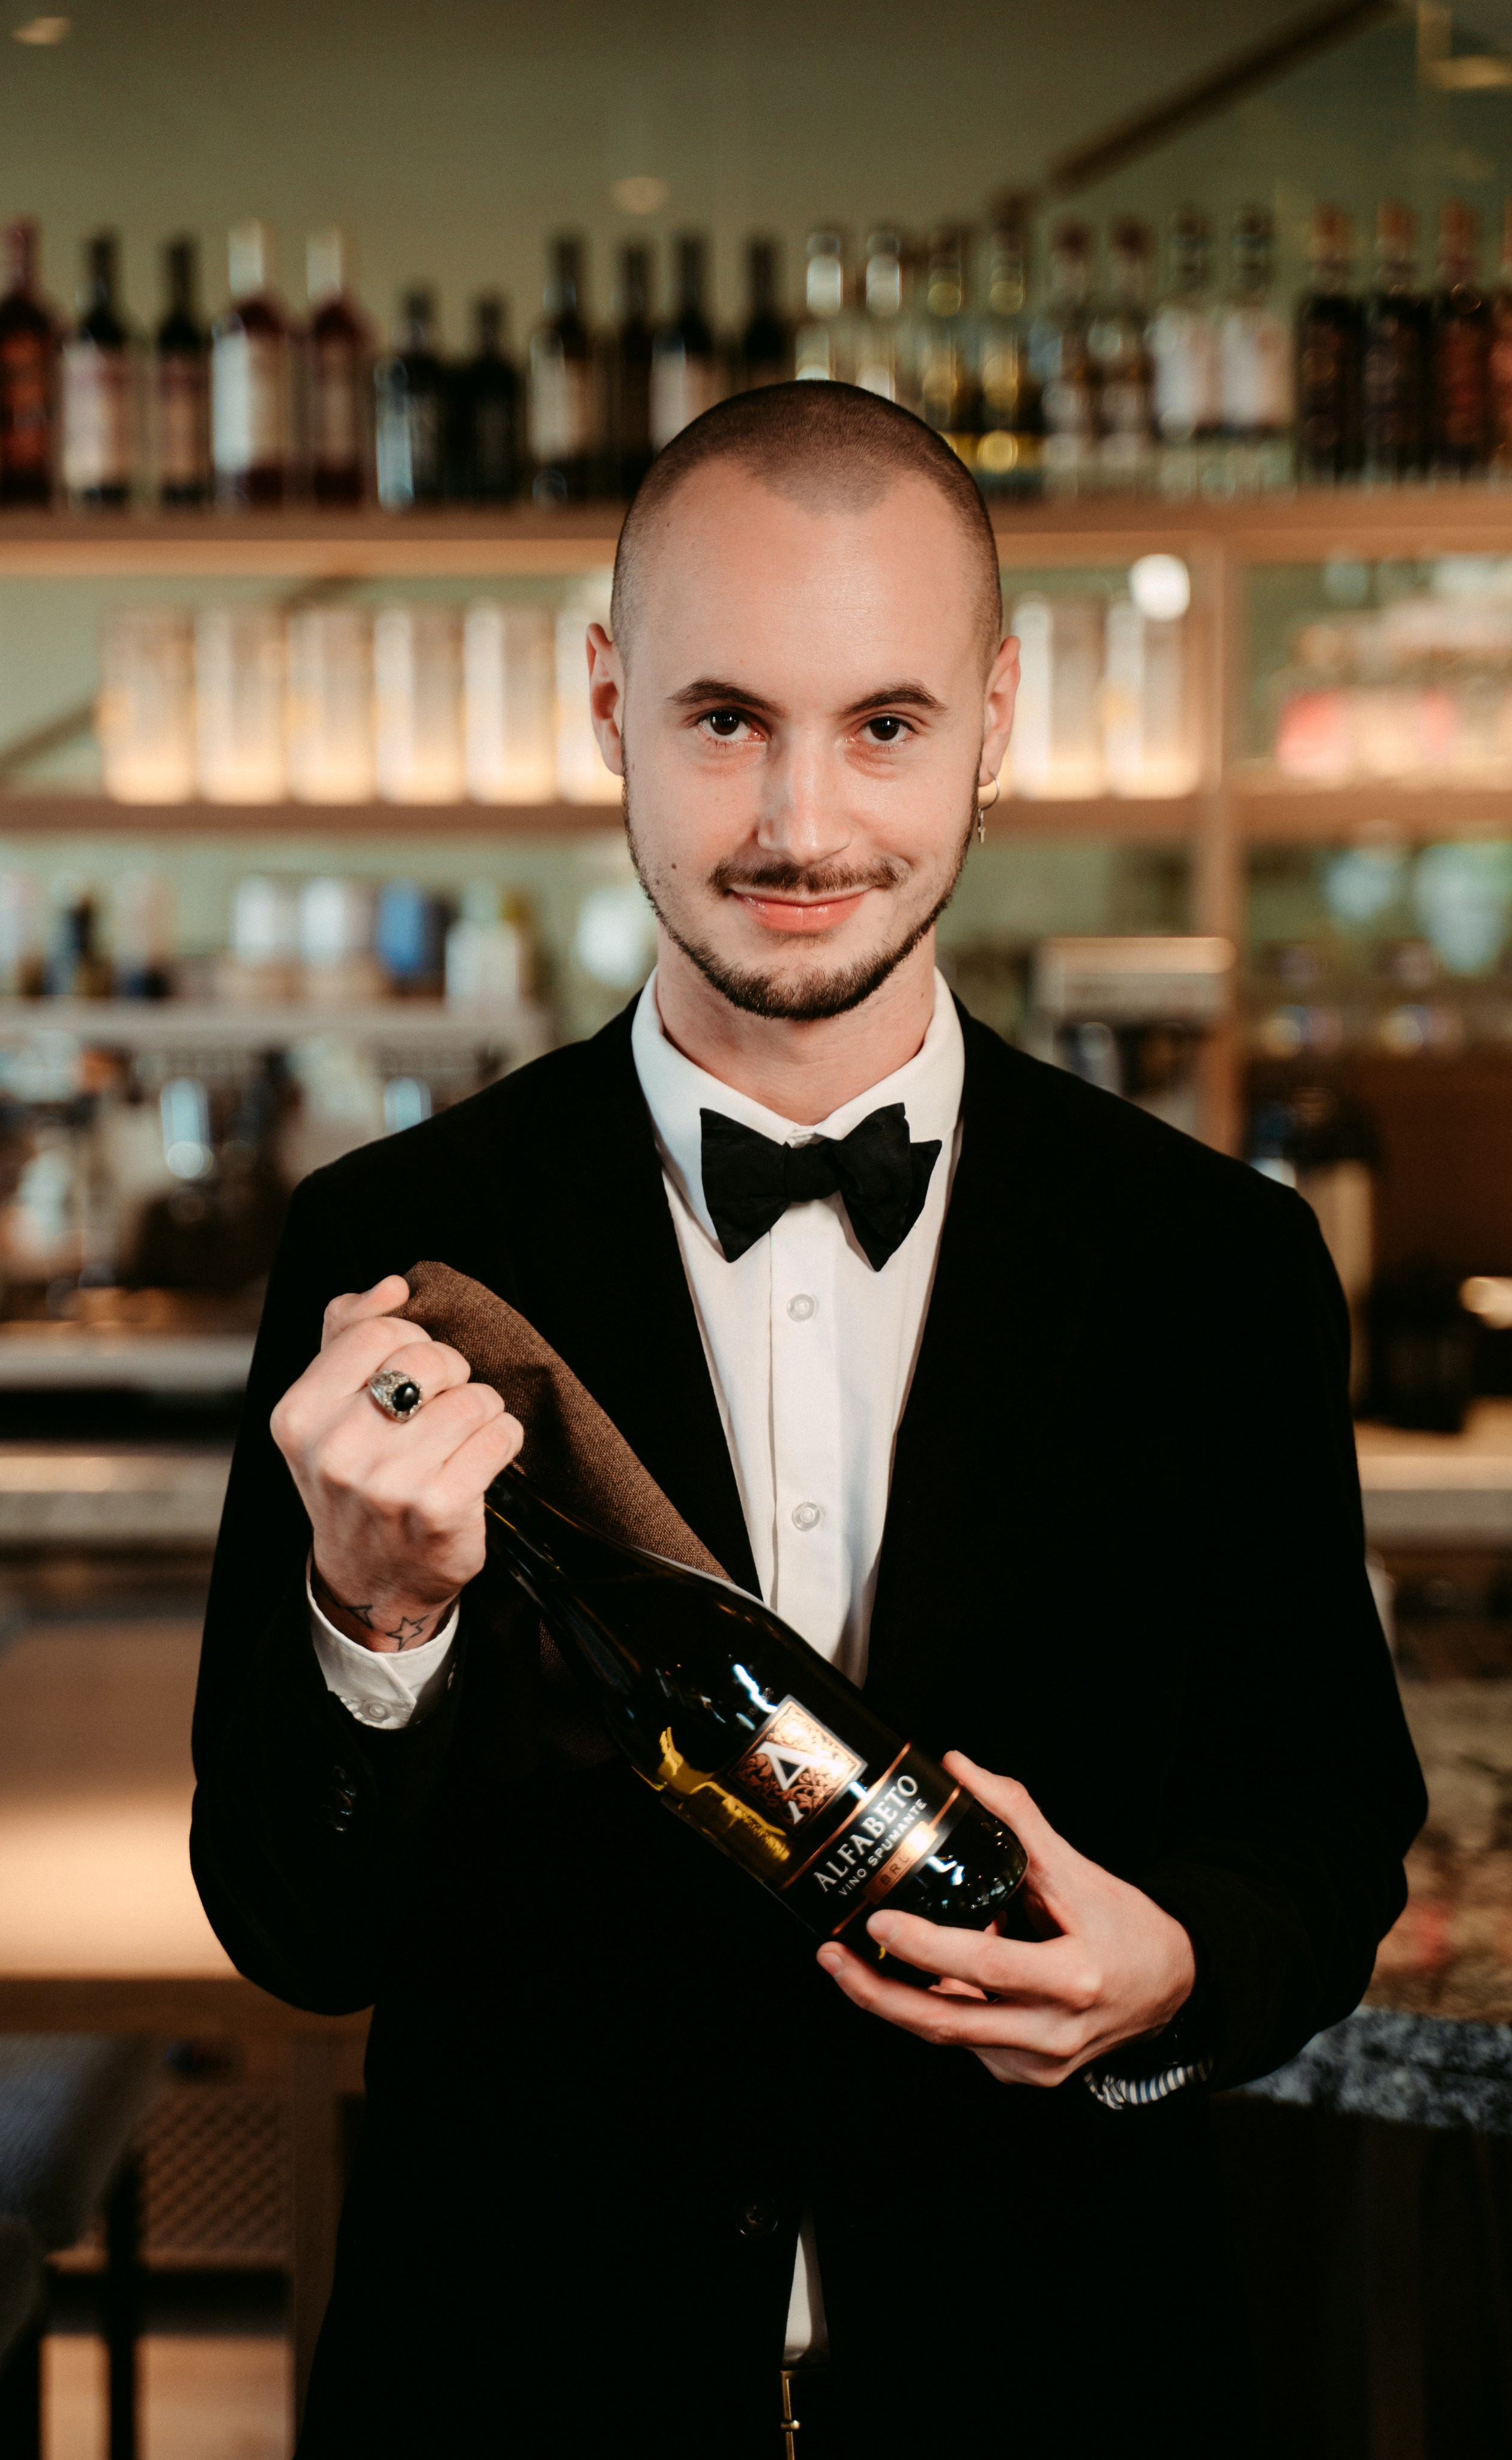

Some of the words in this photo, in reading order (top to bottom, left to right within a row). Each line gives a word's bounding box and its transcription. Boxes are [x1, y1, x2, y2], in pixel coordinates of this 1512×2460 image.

[755, 1740, 847, 1825] A
[814, 1775, 918, 1892] ALFABETO
[838, 1868, 868, 1897] VINO
[867, 1798, 928, 1867] SPUMANTE
[879, 1843, 917, 1885] BRU
